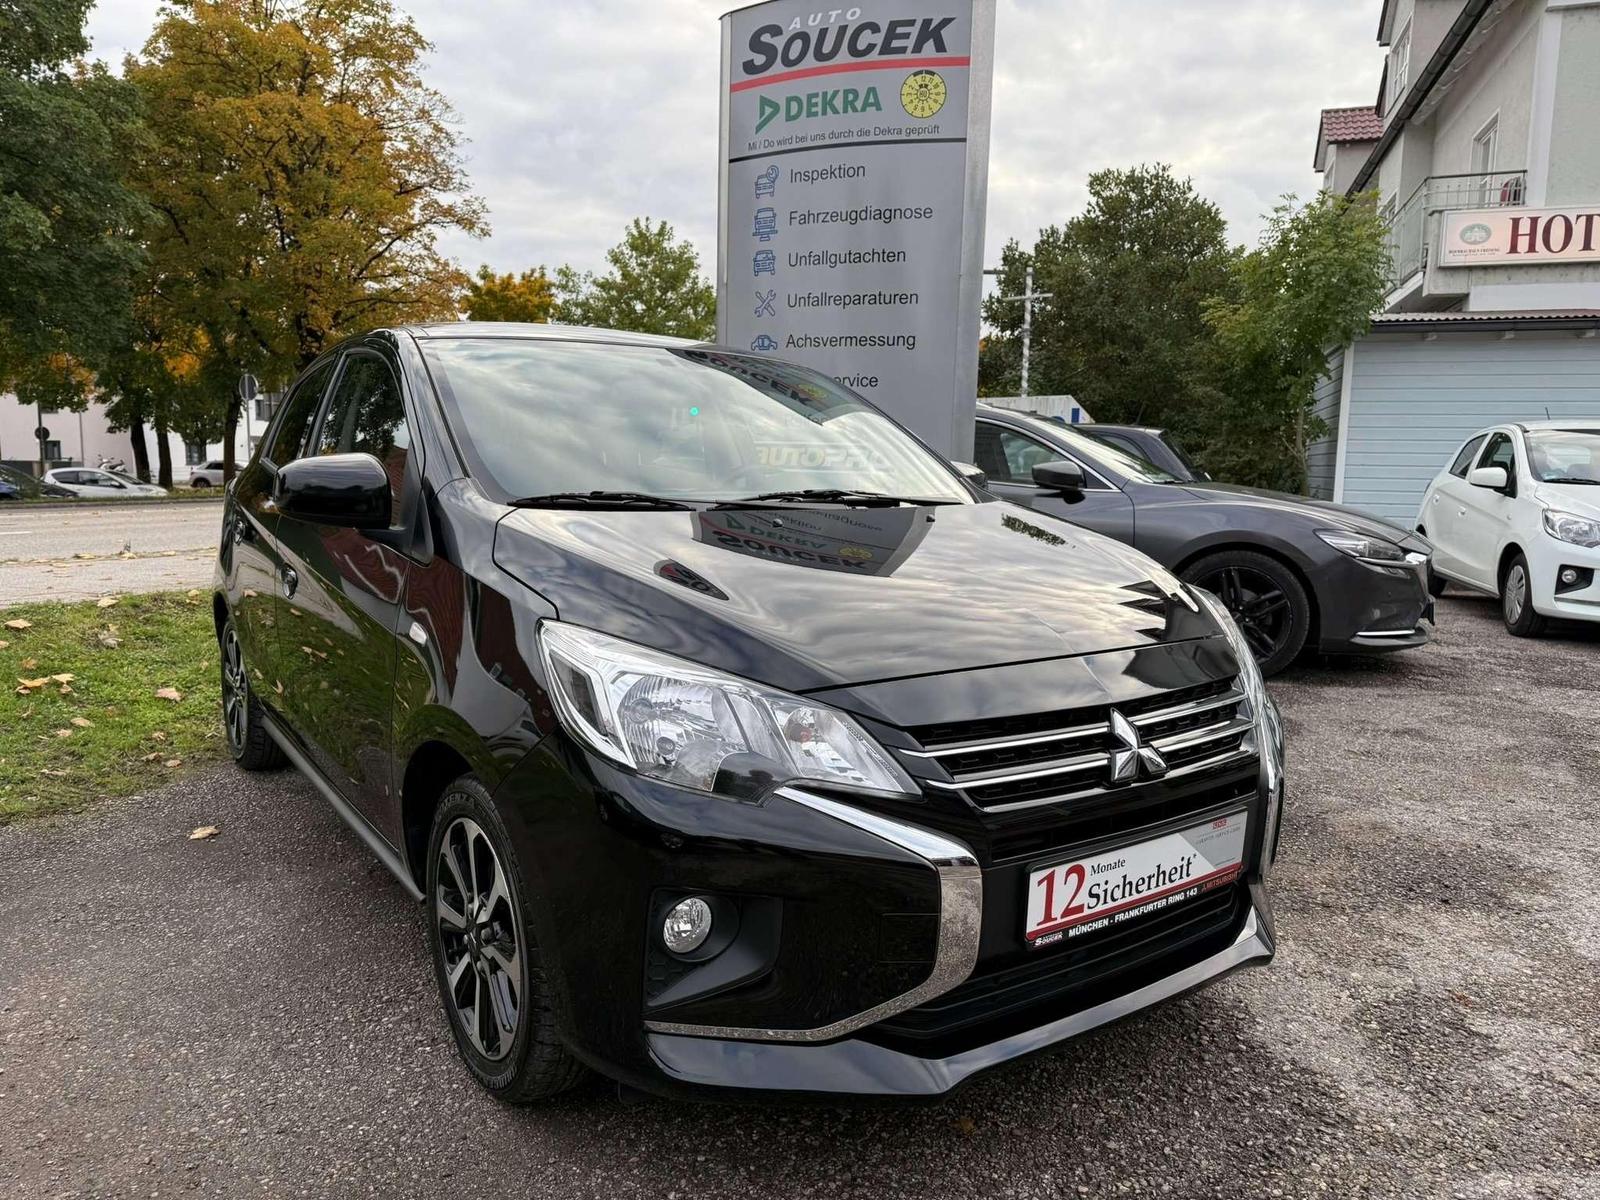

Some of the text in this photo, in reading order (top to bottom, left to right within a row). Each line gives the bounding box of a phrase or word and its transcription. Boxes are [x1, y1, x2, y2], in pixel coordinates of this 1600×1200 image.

[788, 7, 862, 31] AUTO
[742, 17, 957, 76] SOUCEK
[784, 86, 883, 122] DEKRA
[763, 140, 775, 149] Do
[776, 137, 793, 147] wird
[795, 134, 808, 144] bei
[810, 132, 826, 142] uns
[828, 129, 854, 140] durch
[856, 128, 871, 138] die
[873, 126, 903, 137] Dekra
[905, 124, 940, 138] geprüft
[790, 163, 866, 185] Inspektion
[788, 205, 934, 227] Fahrzeugdiagnose
[788, 248, 906, 268] Unfallgutachten
[787, 291, 919, 310] Unfallreparaturen
[785, 333, 916, 350] Achsvermessung
[833, 372, 879, 388] ervice
[1036, 857, 1126, 927] 12 Monate
[1068, 917, 1109, 938] MÜNCHEN
[1114, 898, 1167, 922] FRANKFURTER
[1167, 891, 1185, 906] RING
[1186, 887, 1198, 899] 143
